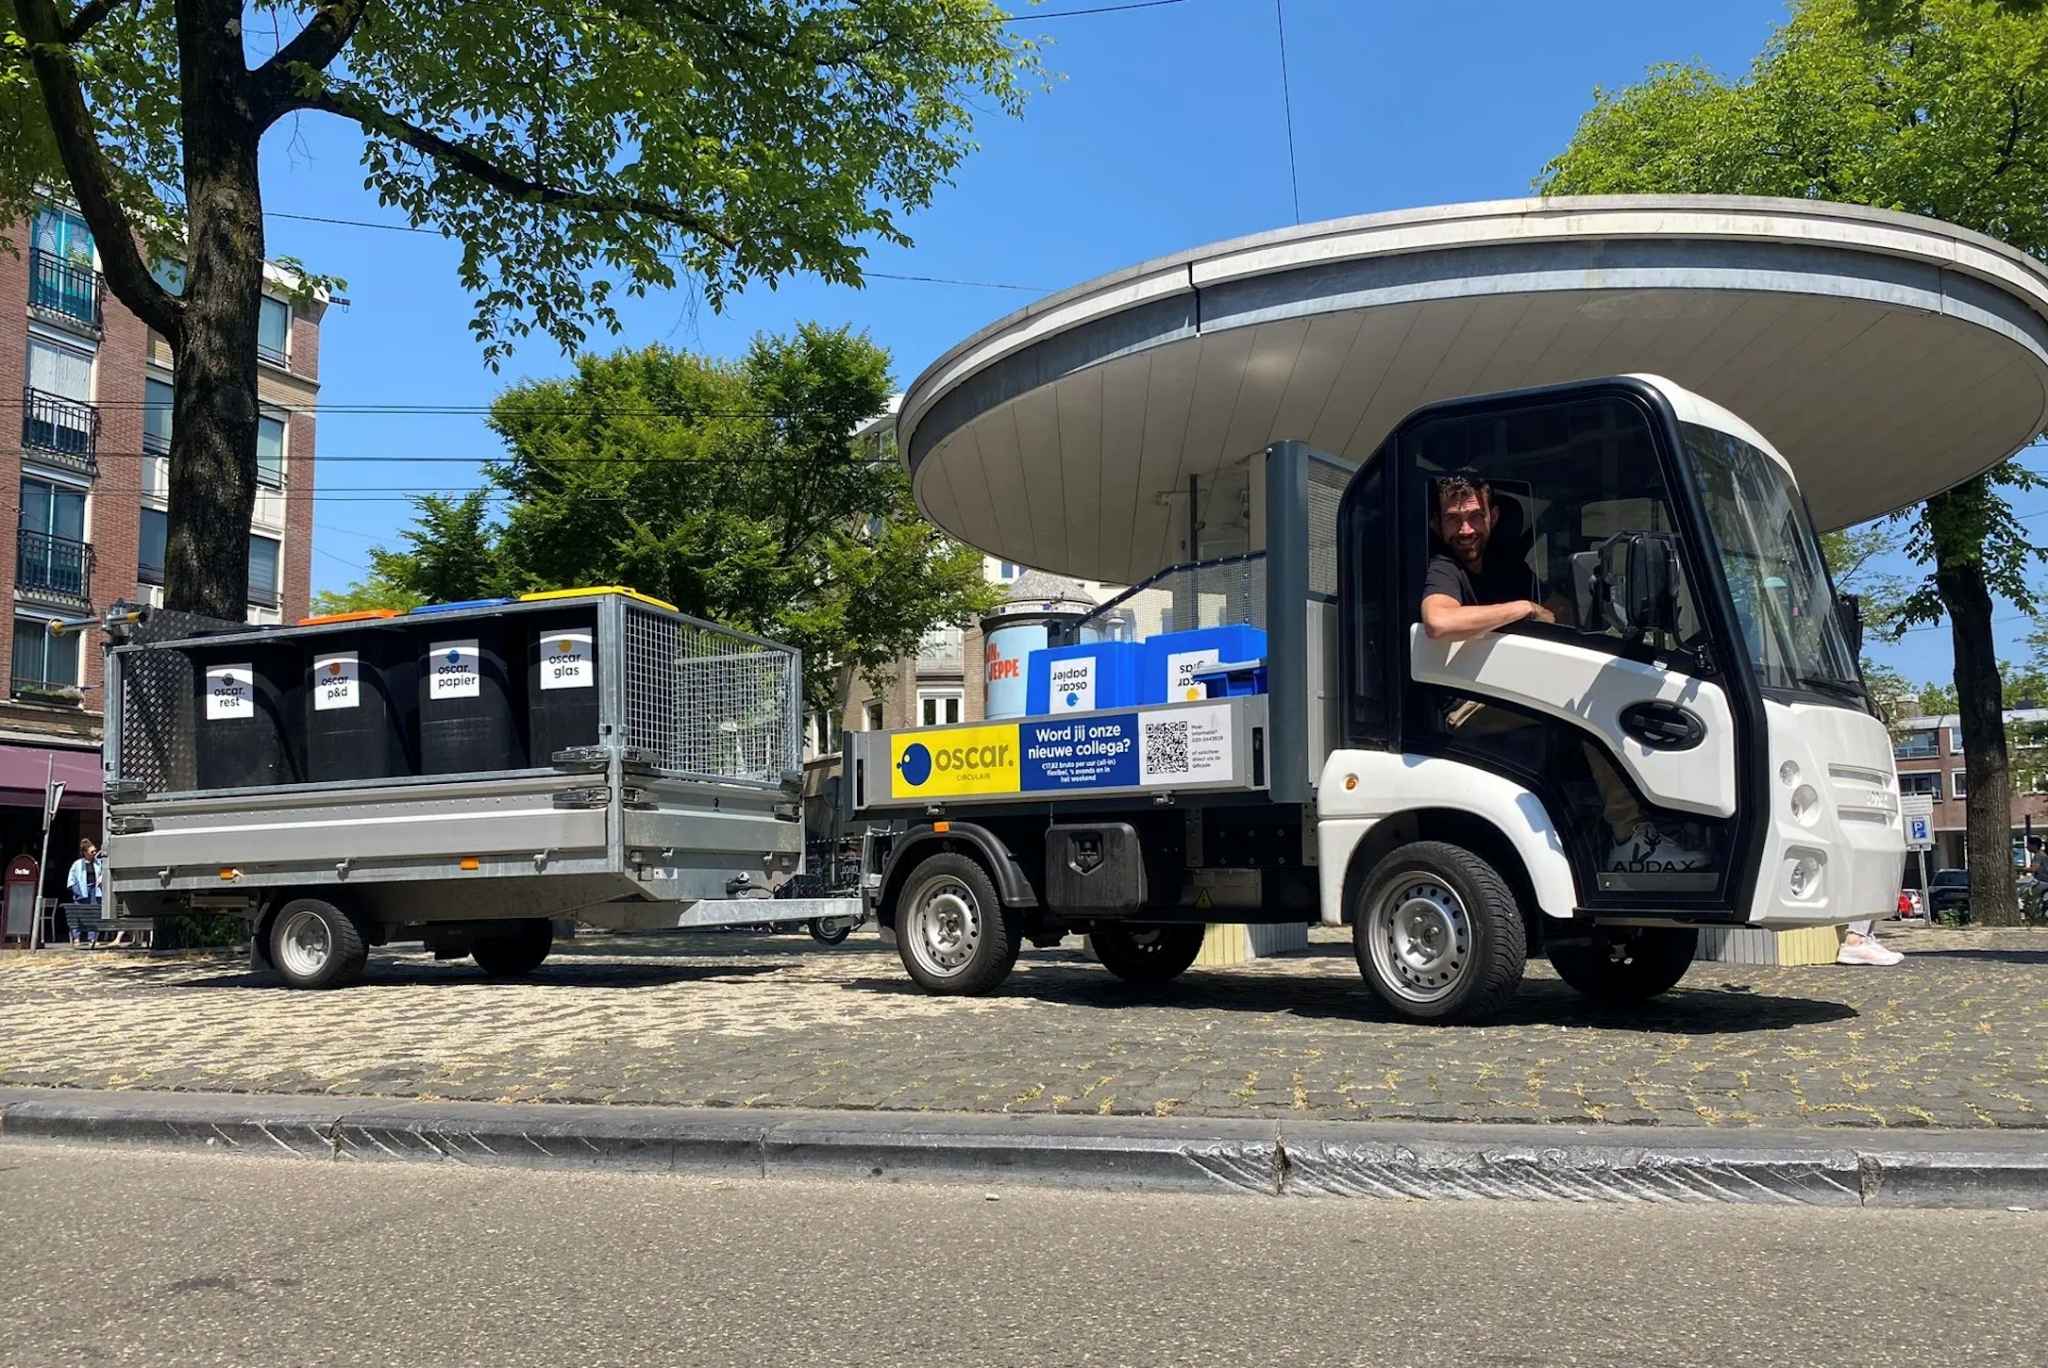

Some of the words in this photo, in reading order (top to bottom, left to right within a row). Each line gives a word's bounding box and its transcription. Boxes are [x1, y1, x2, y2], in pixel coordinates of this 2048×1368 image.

[438, 664, 471, 675] oscar.
[554, 665, 580, 679] glas
[1052, 666, 1088, 682] papier
[438, 674, 477, 690] papier
[214, 687, 245, 697] oscar.
[327, 686, 348, 700] p&d
[220, 696, 240, 708] rest
[1036, 726, 1071, 742] Word
[1074, 725, 1086, 742] jij
[1089, 724, 1121, 738] onze
[1028, 745, 1073, 759] nieuwe
[1076, 738, 1131, 756] collega?
[935, 744, 1014, 772] oscar.
[1914, 821, 1923, 833] P
[1614, 860, 1697, 873] ADDAX
